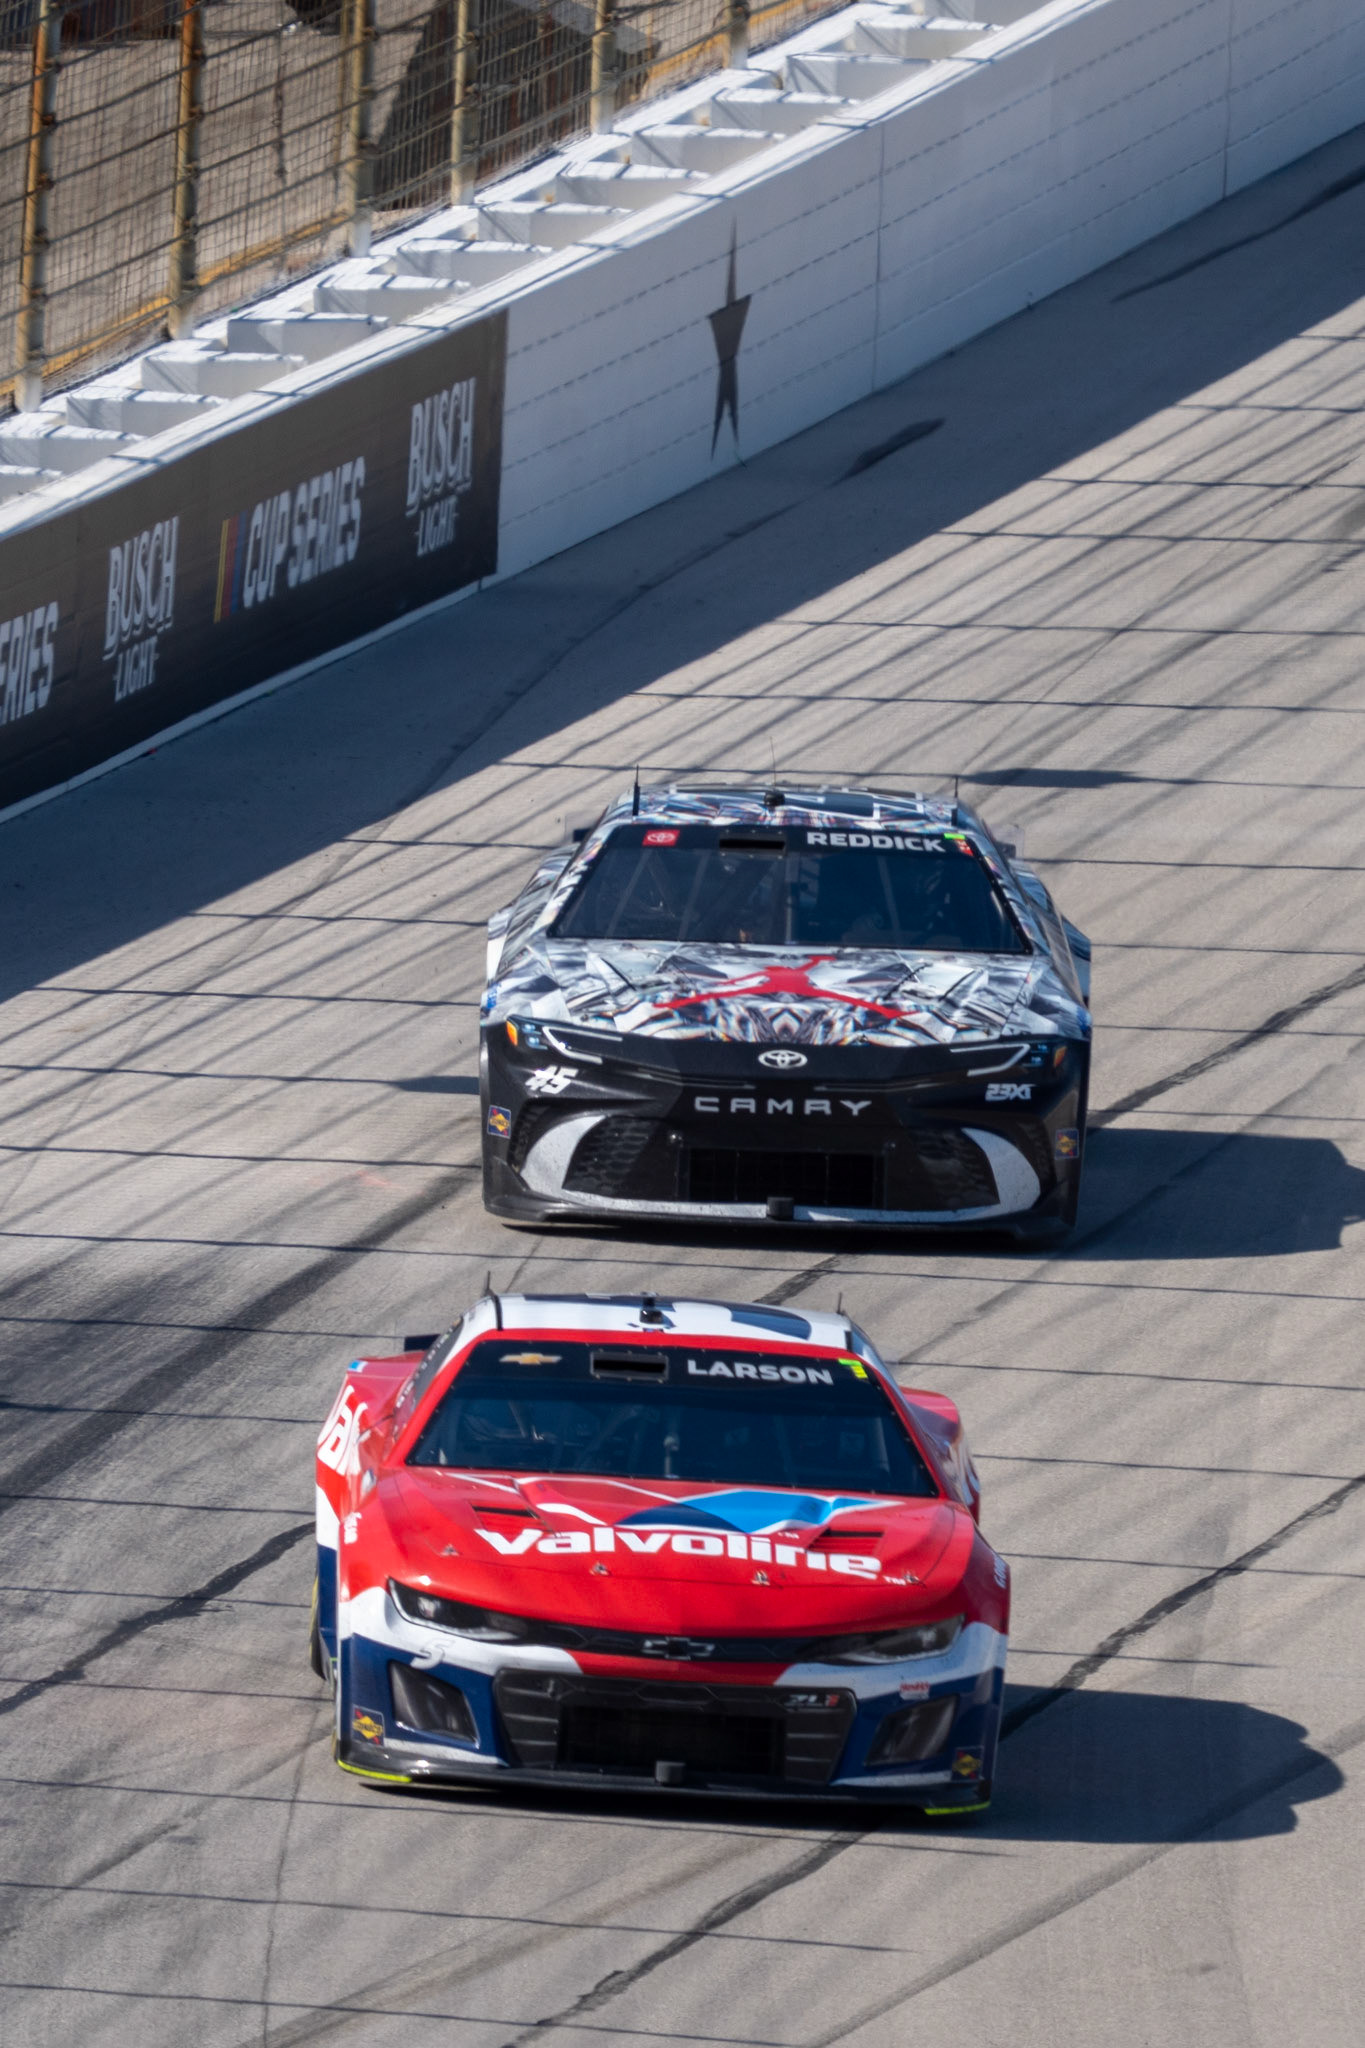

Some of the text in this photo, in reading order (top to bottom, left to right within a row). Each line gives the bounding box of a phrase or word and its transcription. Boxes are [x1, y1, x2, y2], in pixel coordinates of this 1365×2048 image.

[406, 377, 476, 516] BUSCH
[243, 456, 365, 609] CUP SERIES
[415, 498, 459, 557] LIGHT
[103, 516, 179, 661] BUSCH
[113, 637, 159, 701] LIGHT
[806, 831, 946, 853] REDDICK
[525, 1065, 579, 1094] 45
[694, 1096, 872, 1116] CAMRY
[687, 1359, 834, 1386] LARSON
[474, 1526, 882, 1580] Valvoline
